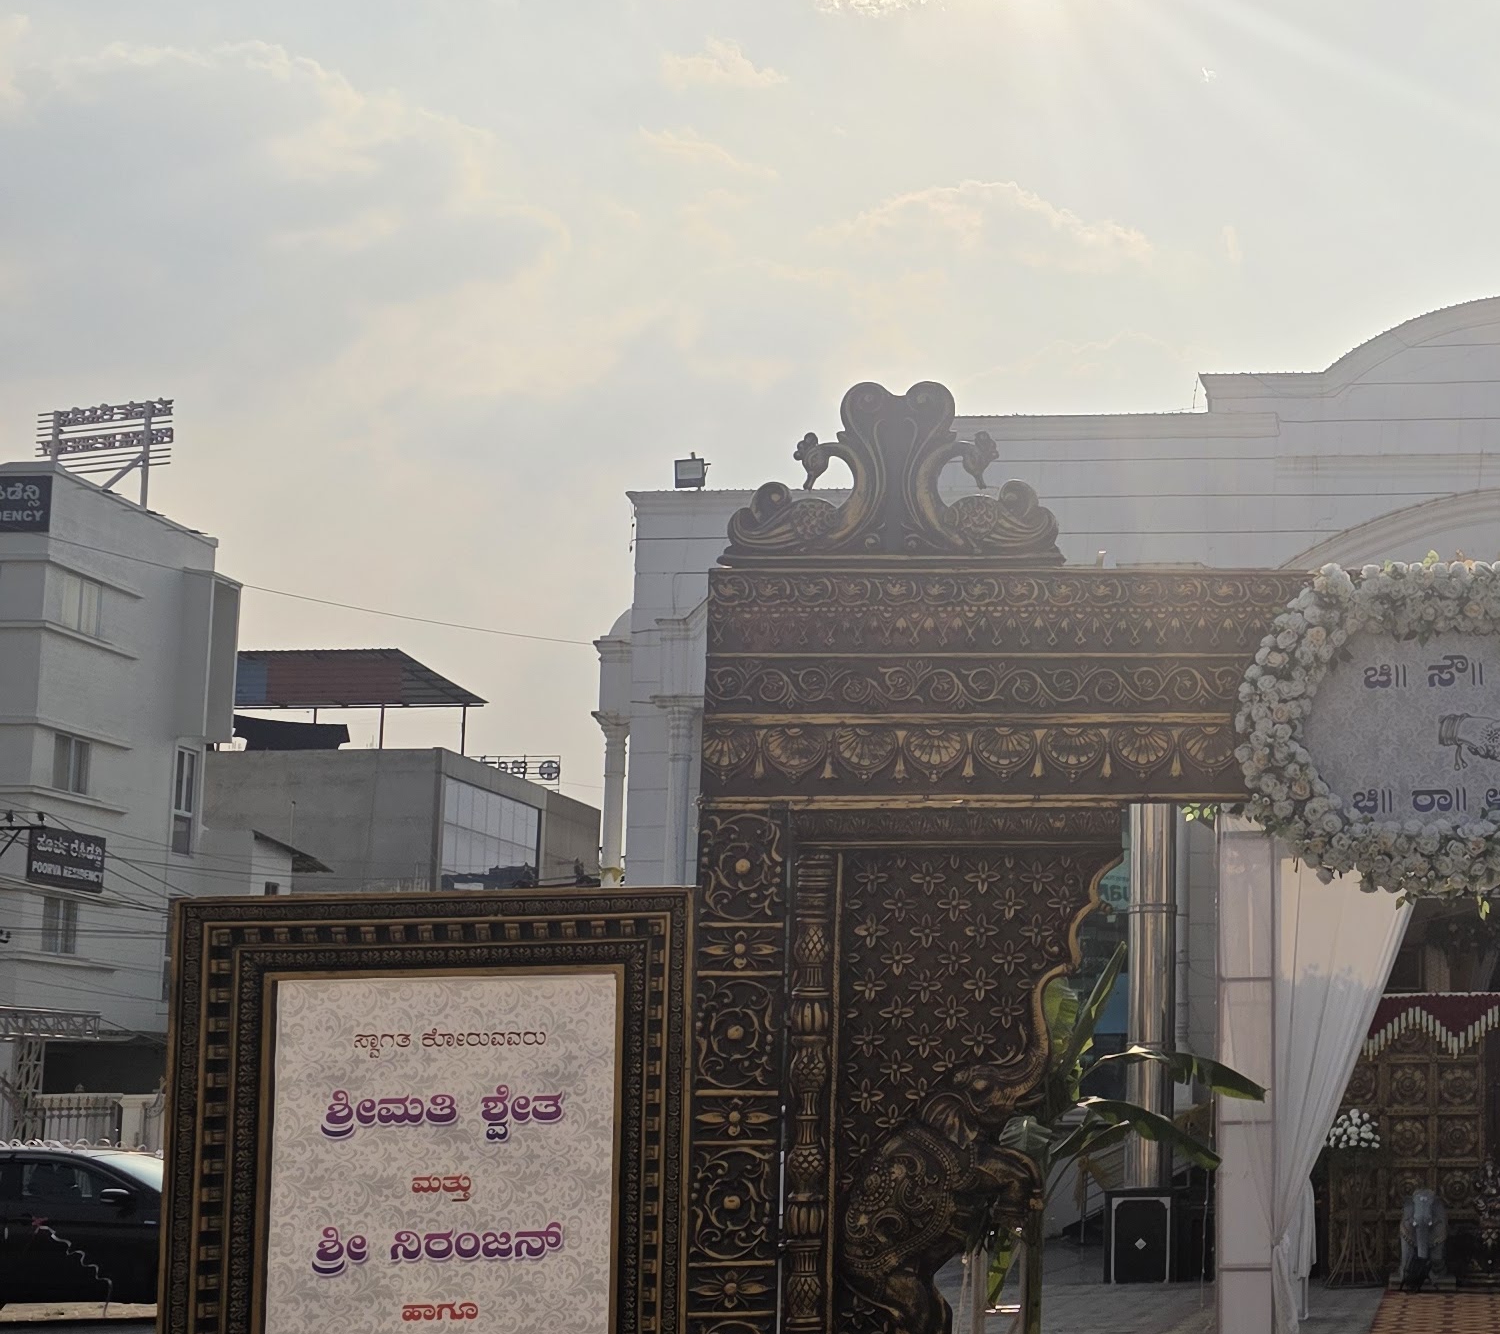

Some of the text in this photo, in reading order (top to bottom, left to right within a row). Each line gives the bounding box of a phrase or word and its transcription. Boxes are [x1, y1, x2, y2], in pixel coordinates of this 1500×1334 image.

[0, 510, 44, 521] ENCY
[32, 860, 62, 876] POORVA
[355, 1028, 546, 1058] ಸ್ವಾಗತ ಕೋರುವವರು
[321, 1085, 565, 1143] ಶ್ರೀಮತಿ ಶ್ವೇತ
[412, 1174, 471, 1202] ಮತ್ತು
[312, 1222, 562, 1274] ಶ್ರೀ ನಿರಂಜನ್
[402, 1302, 478, 1321] ಹಾಗೂ
